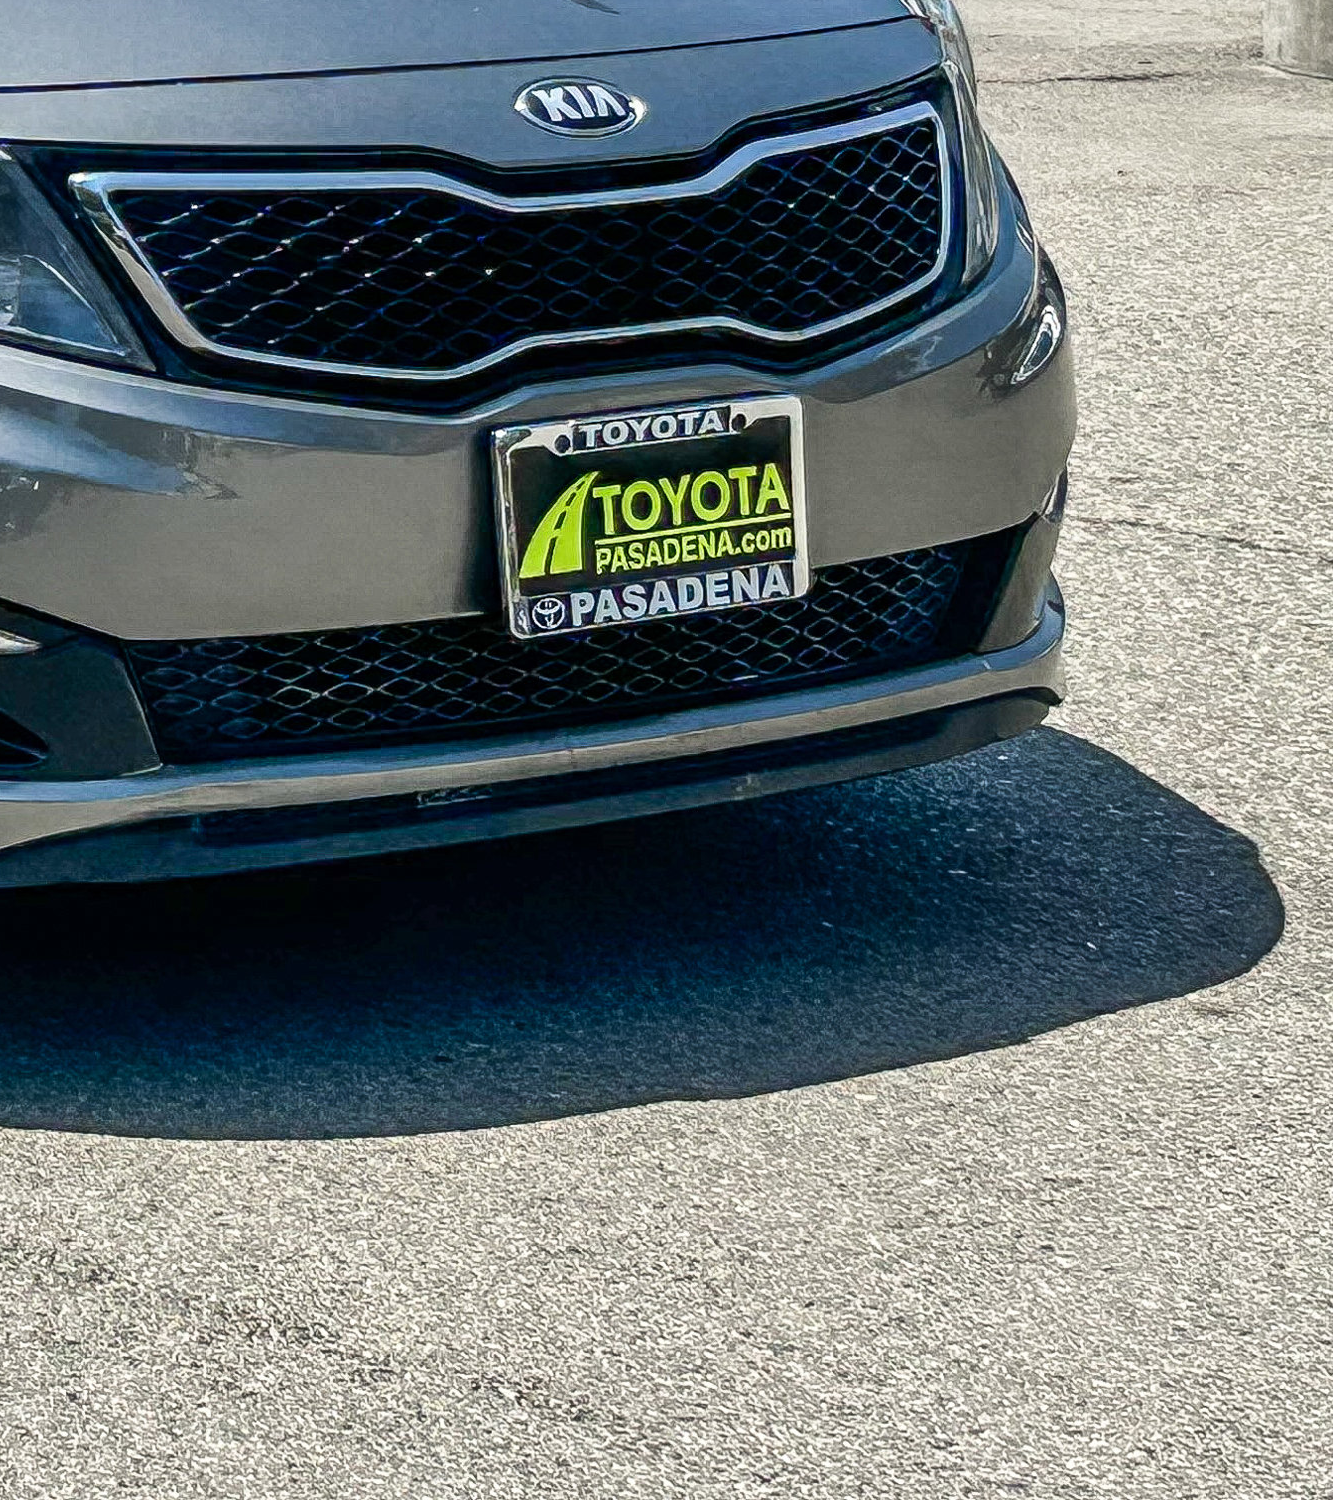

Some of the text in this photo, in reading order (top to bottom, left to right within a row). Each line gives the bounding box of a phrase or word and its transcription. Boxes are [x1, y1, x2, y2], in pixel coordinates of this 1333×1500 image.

[532, 85, 627, 122] KIA
[580, 410, 724, 449] TOYOTA
[593, 462, 790, 536] TOYOTA
[596, 525, 793, 575] PASADENA.com
[570, 564, 790, 627] PASADENA
